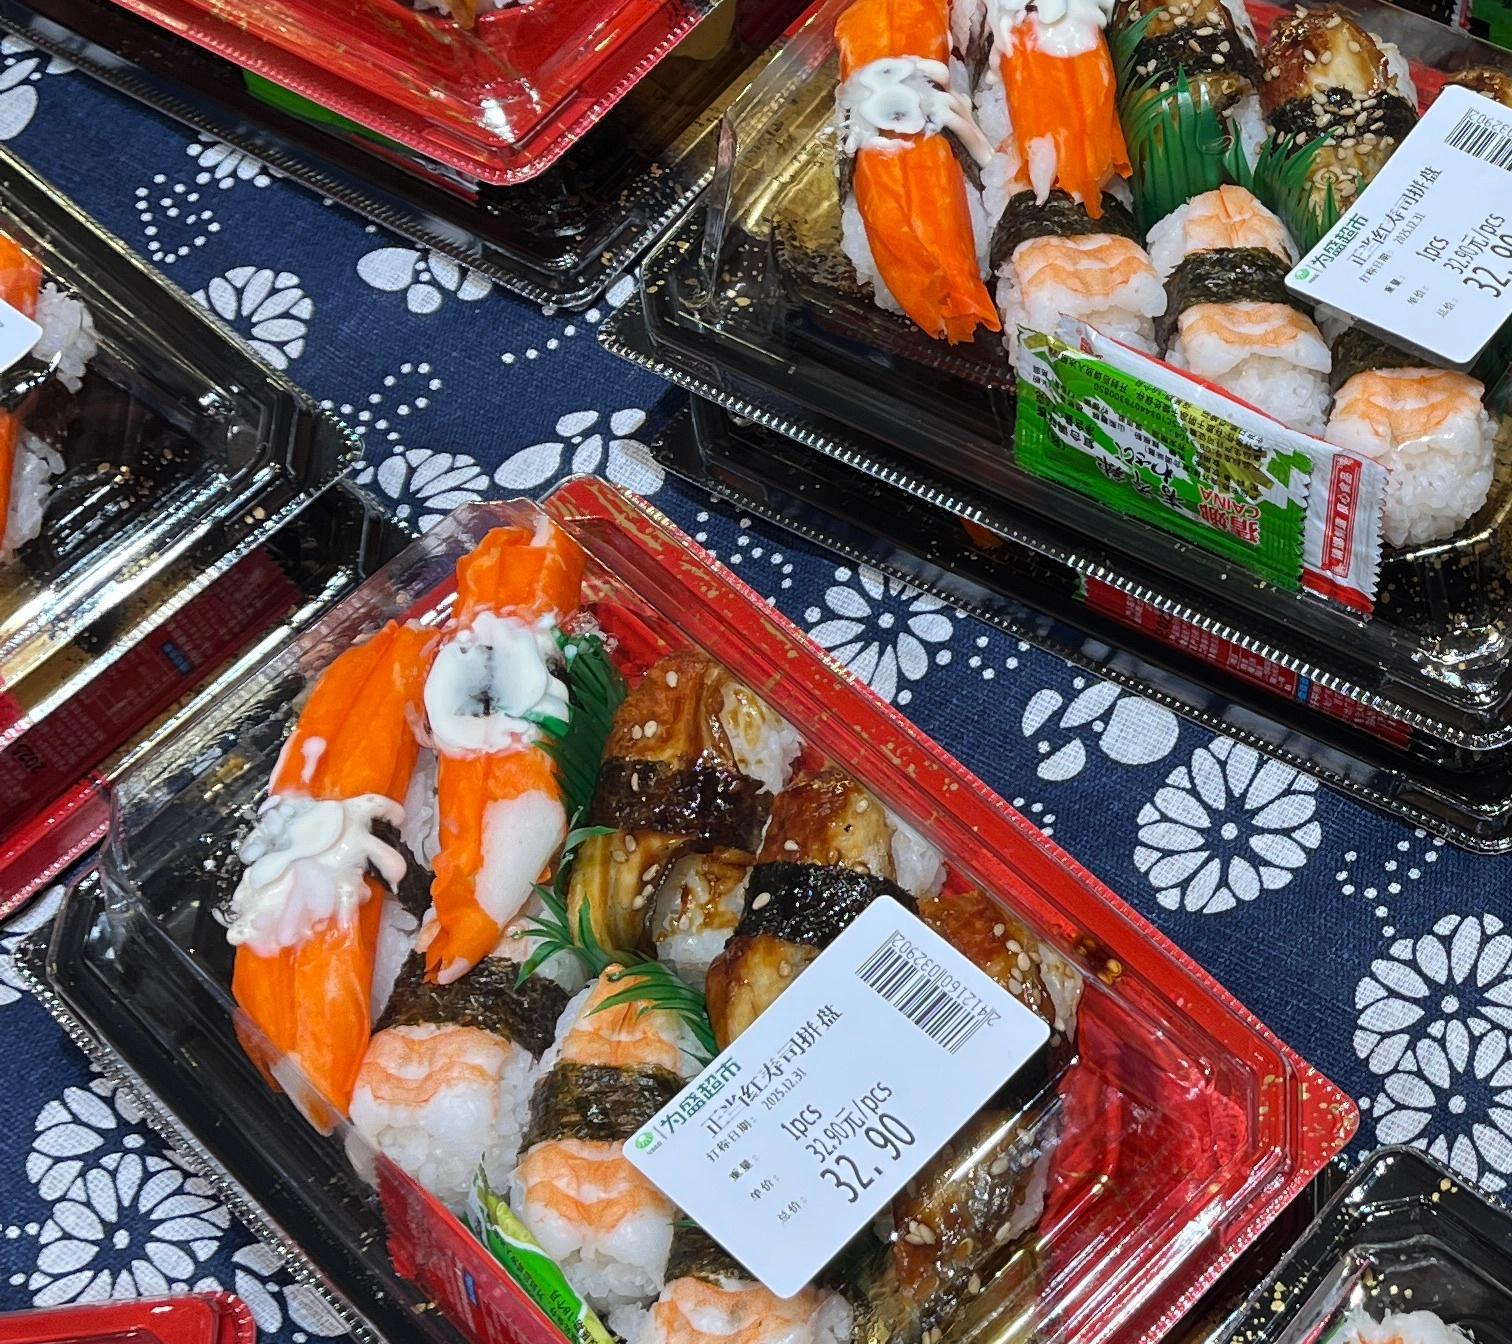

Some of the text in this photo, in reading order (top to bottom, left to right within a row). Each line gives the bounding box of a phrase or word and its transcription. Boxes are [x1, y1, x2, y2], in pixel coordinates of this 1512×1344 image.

[1309, 211, 1369, 269] 为盛超市
[1350, 165, 1442, 266] 正当红寿司拼盘
[1442, 212, 1506, 275] 32.90元/pcs
[1414, 234, 1450, 262] 1pcs
[1197, 480, 1260, 524] CAINA
[1197, 497, 1259, 546] 猜娜
[659, 1056, 742, 1134] 为盛超市
[700, 1003, 843, 1139] 正当红寿司拼盘
[760, 1066, 807, 1111] 2025.12.31
[779, 1103, 822, 1141] 1pcs
[804, 1080, 893, 1164] 32.90元/pcs
[818, 1112, 916, 1203] 32.90
